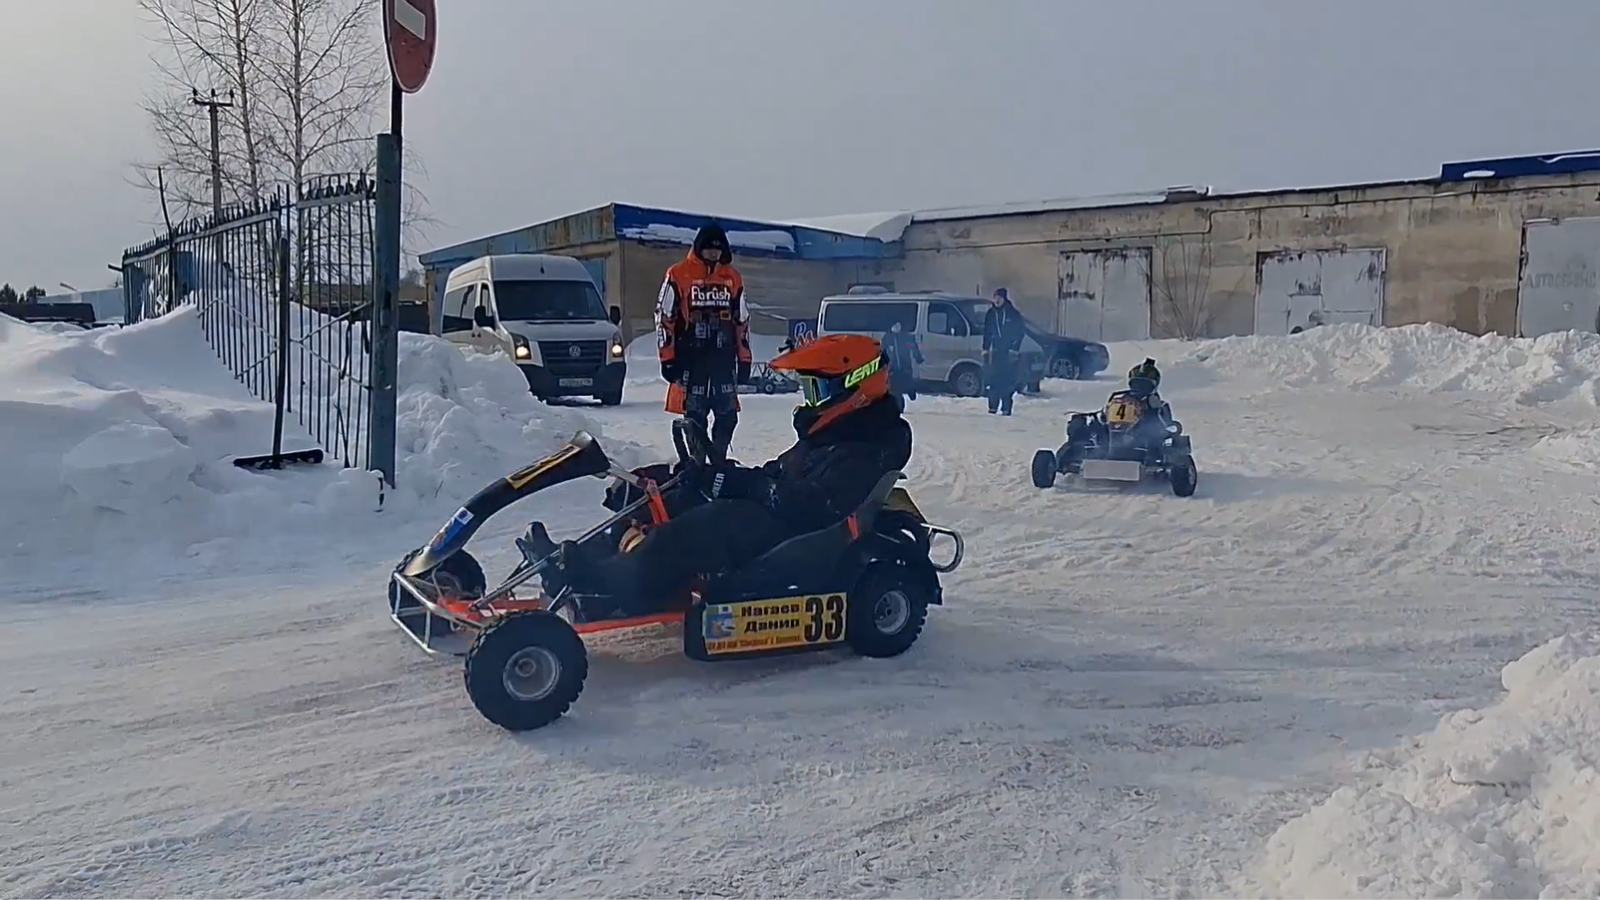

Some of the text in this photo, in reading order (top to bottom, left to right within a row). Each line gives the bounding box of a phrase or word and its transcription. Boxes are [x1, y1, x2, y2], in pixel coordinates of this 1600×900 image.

[1116, 404, 1126, 420] 4
[744, 617, 800, 633] Данир
[804, 595, 844, 642] 33
